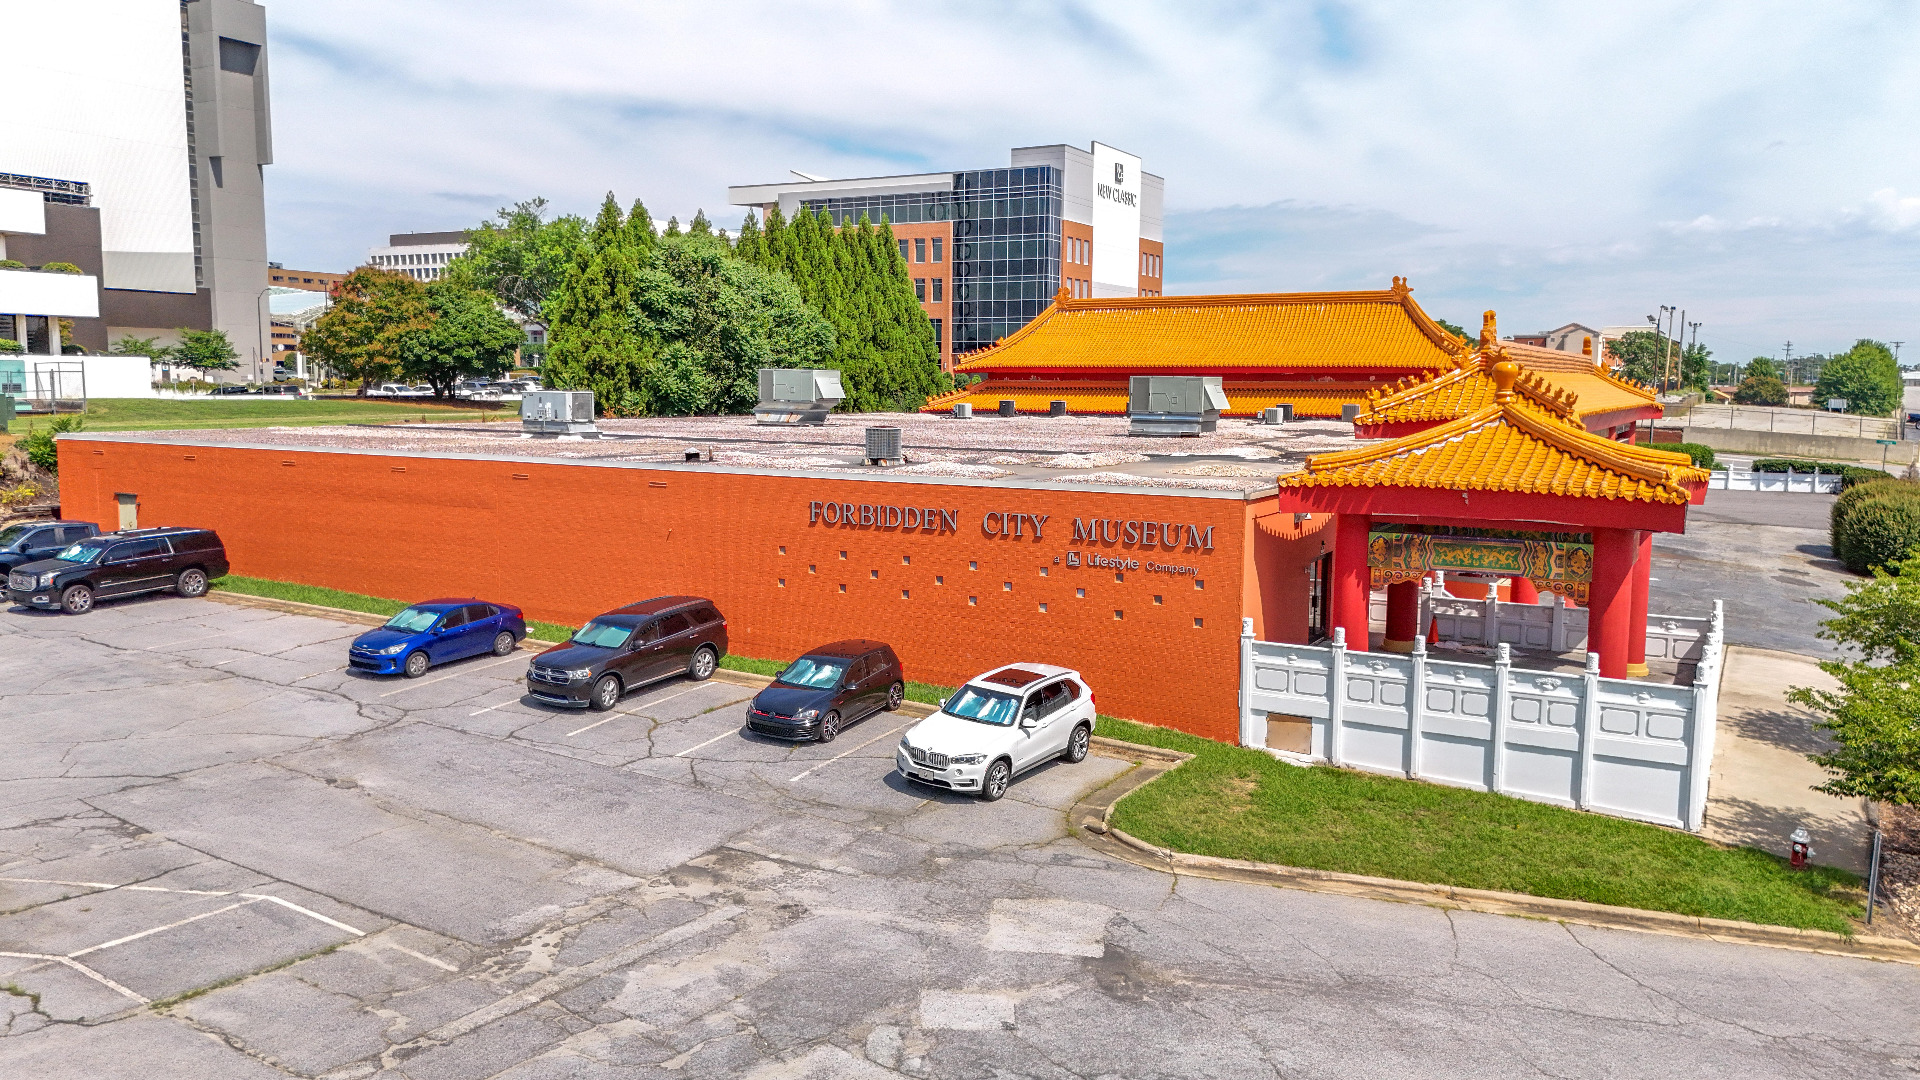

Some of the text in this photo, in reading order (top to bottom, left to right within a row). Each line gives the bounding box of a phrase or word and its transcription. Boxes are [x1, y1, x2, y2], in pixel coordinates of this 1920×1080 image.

[1097, 183, 1136, 207] NEW CLASSIC
[809, 501, 1215, 549] FORBIDDEN CITY MUSEUM
[1053, 555, 1060, 563] a
[1087, 553, 1139, 570] Lifestyle
[1146, 561, 1199, 576] Company
